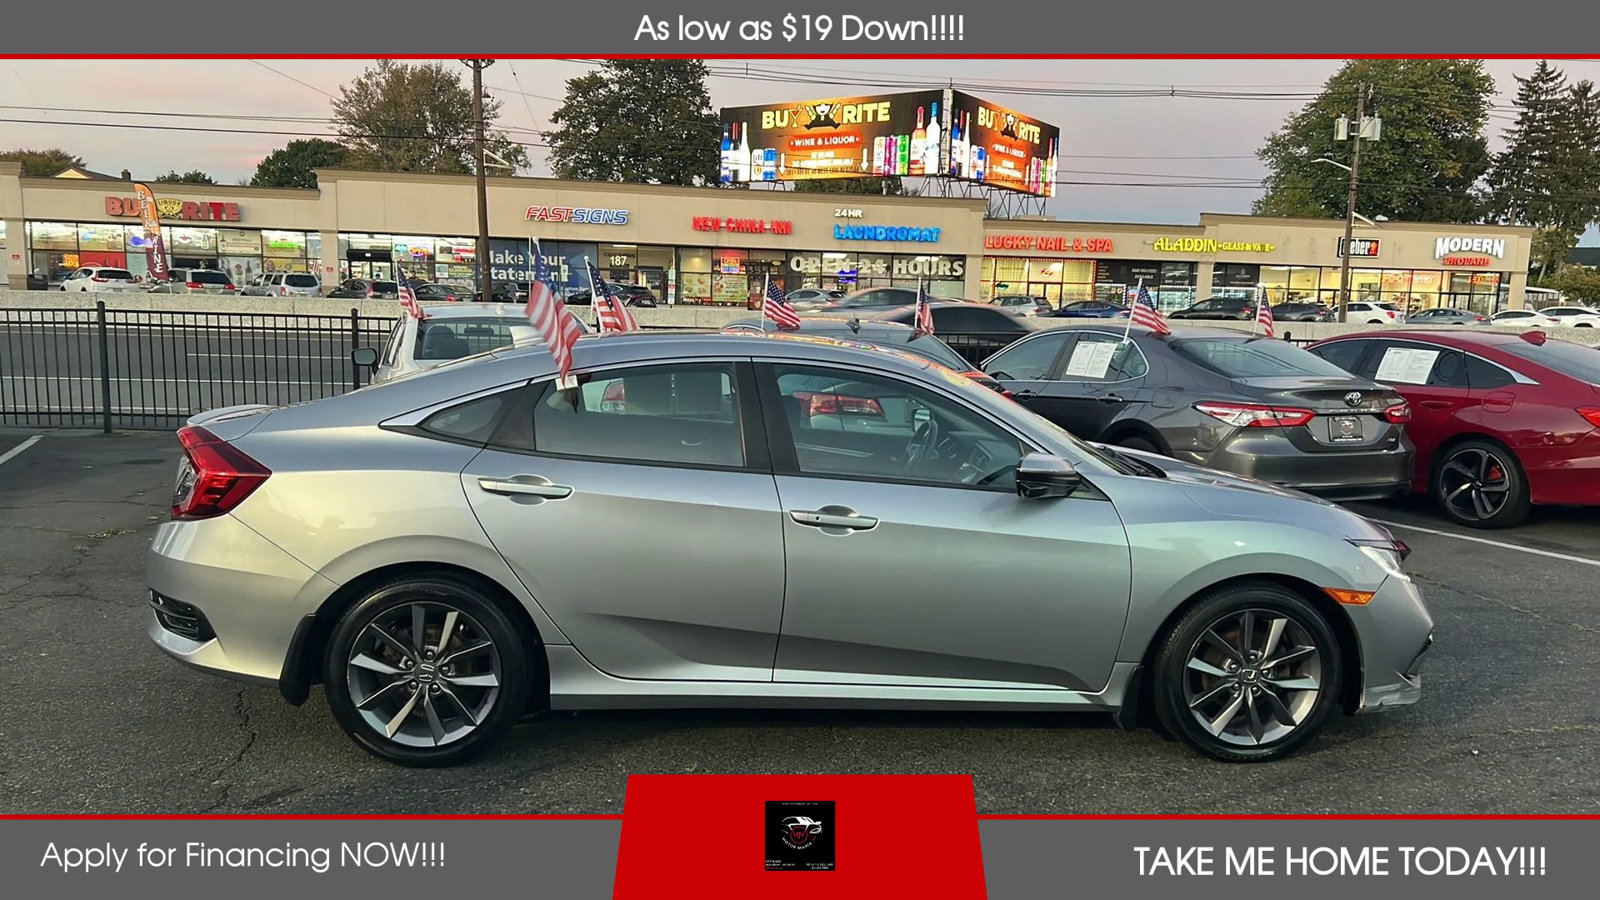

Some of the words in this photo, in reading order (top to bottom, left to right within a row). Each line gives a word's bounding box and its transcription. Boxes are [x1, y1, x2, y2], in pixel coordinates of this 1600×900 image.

[842, 101, 891, 125] RITE
[794, 138, 815, 147] WINE
[817, 137, 823, 146] &
[825, 136, 855, 146] LIQUOR
[1019, 121, 1041, 144] RITE
[137, 191, 152, 230] BEER
[182, 201, 240, 221] RITE
[525, 205, 628, 225] FASTSIGNS
[692, 216, 722, 232] NEW
[726, 218, 766, 234] CHINA
[770, 220, 793, 235] INN
[833, 224, 942, 243] LAUNDROMAT
[152, 235, 164, 273] WINE
[984, 235, 1032, 250] LUCKY
[1036, 236, 1068, 251] NAIL
[1073, 238, 1083, 251] &
[1087, 238, 1114, 253] SPA
[1153, 237, 1217, 253] ALADDIN
[1222, 242, 1245, 251] GLASS
[1252, 243, 1271, 252] VAE
[1342, 239, 1371, 255] eber
[1435, 237, 1505, 260] MODERN
[609, 255, 628, 267] 187
[790, 256, 850, 274] OPEN
[858, 257, 888, 275] 24
[893, 258, 964, 276] HOURS
